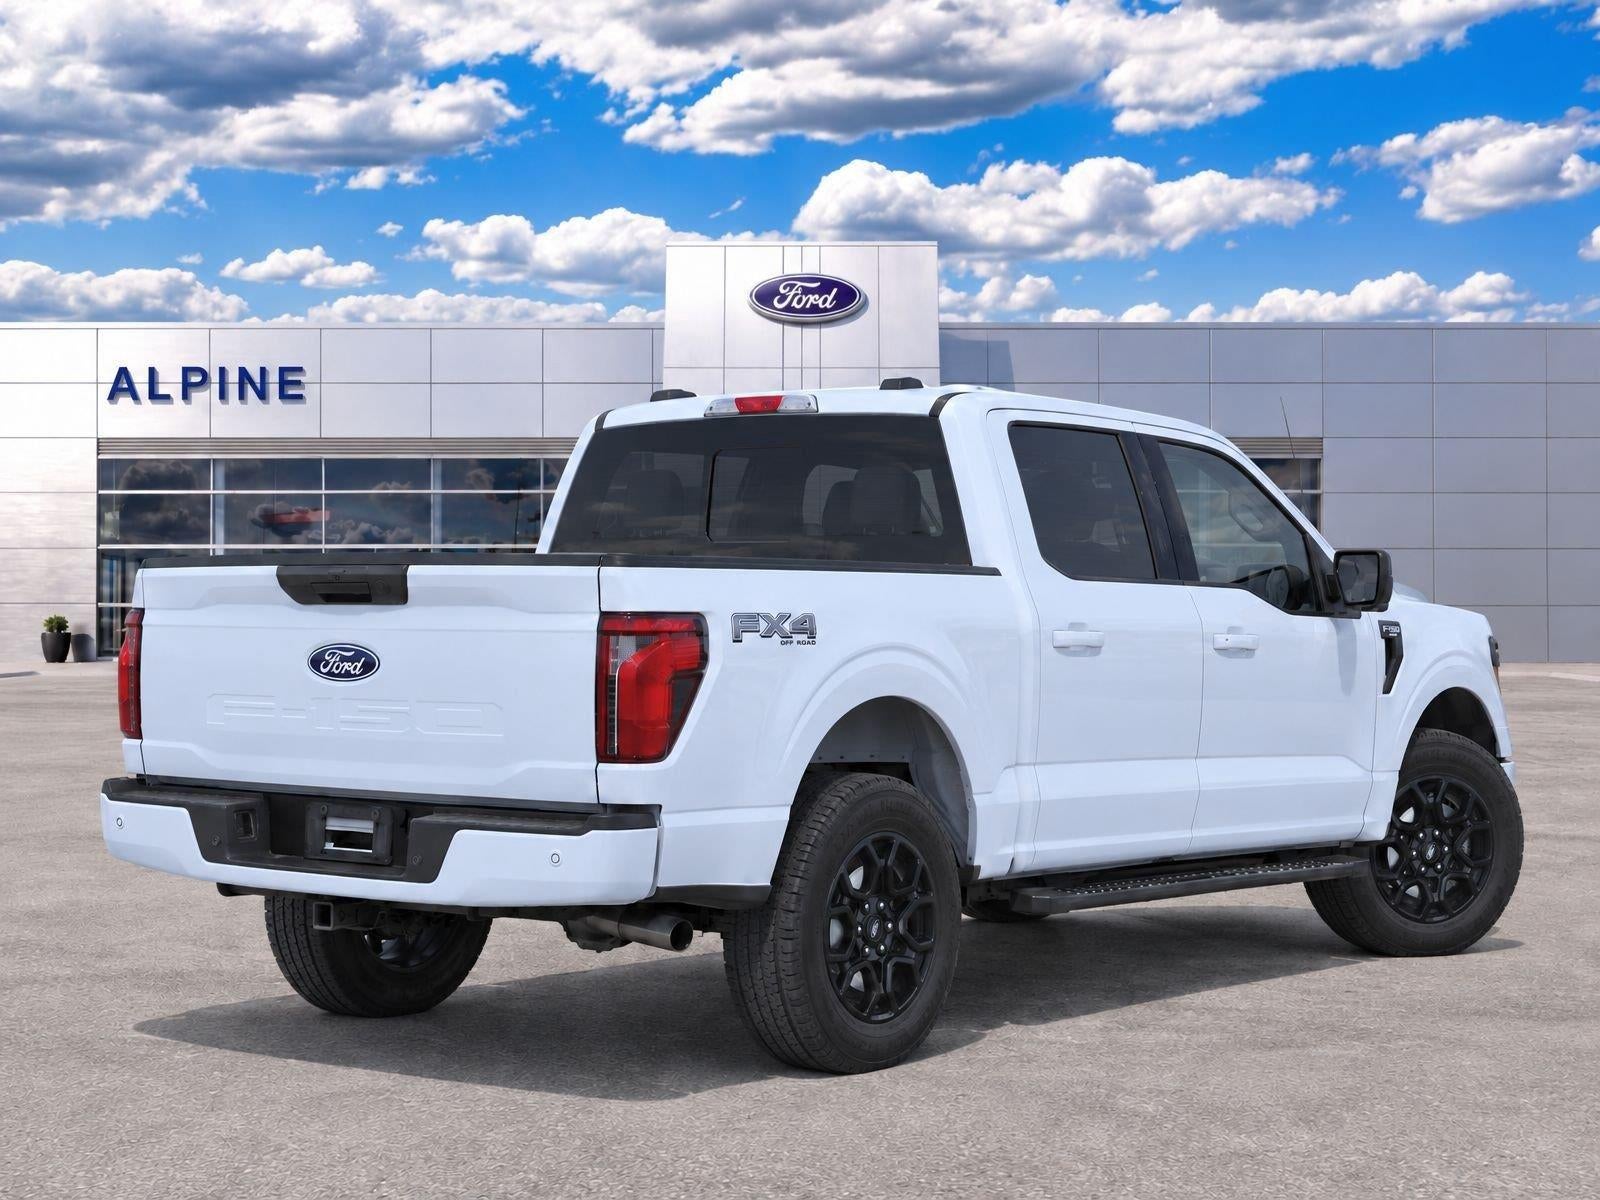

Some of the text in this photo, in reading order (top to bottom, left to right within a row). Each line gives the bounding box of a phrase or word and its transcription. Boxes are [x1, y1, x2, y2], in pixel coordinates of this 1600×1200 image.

[773, 280, 838, 309] Ford
[107, 366, 305, 402] ALPINE
[731, 612, 817, 643] FX4
[320, 649, 366, 675] Ford
[206, 692, 504, 737] F-150
